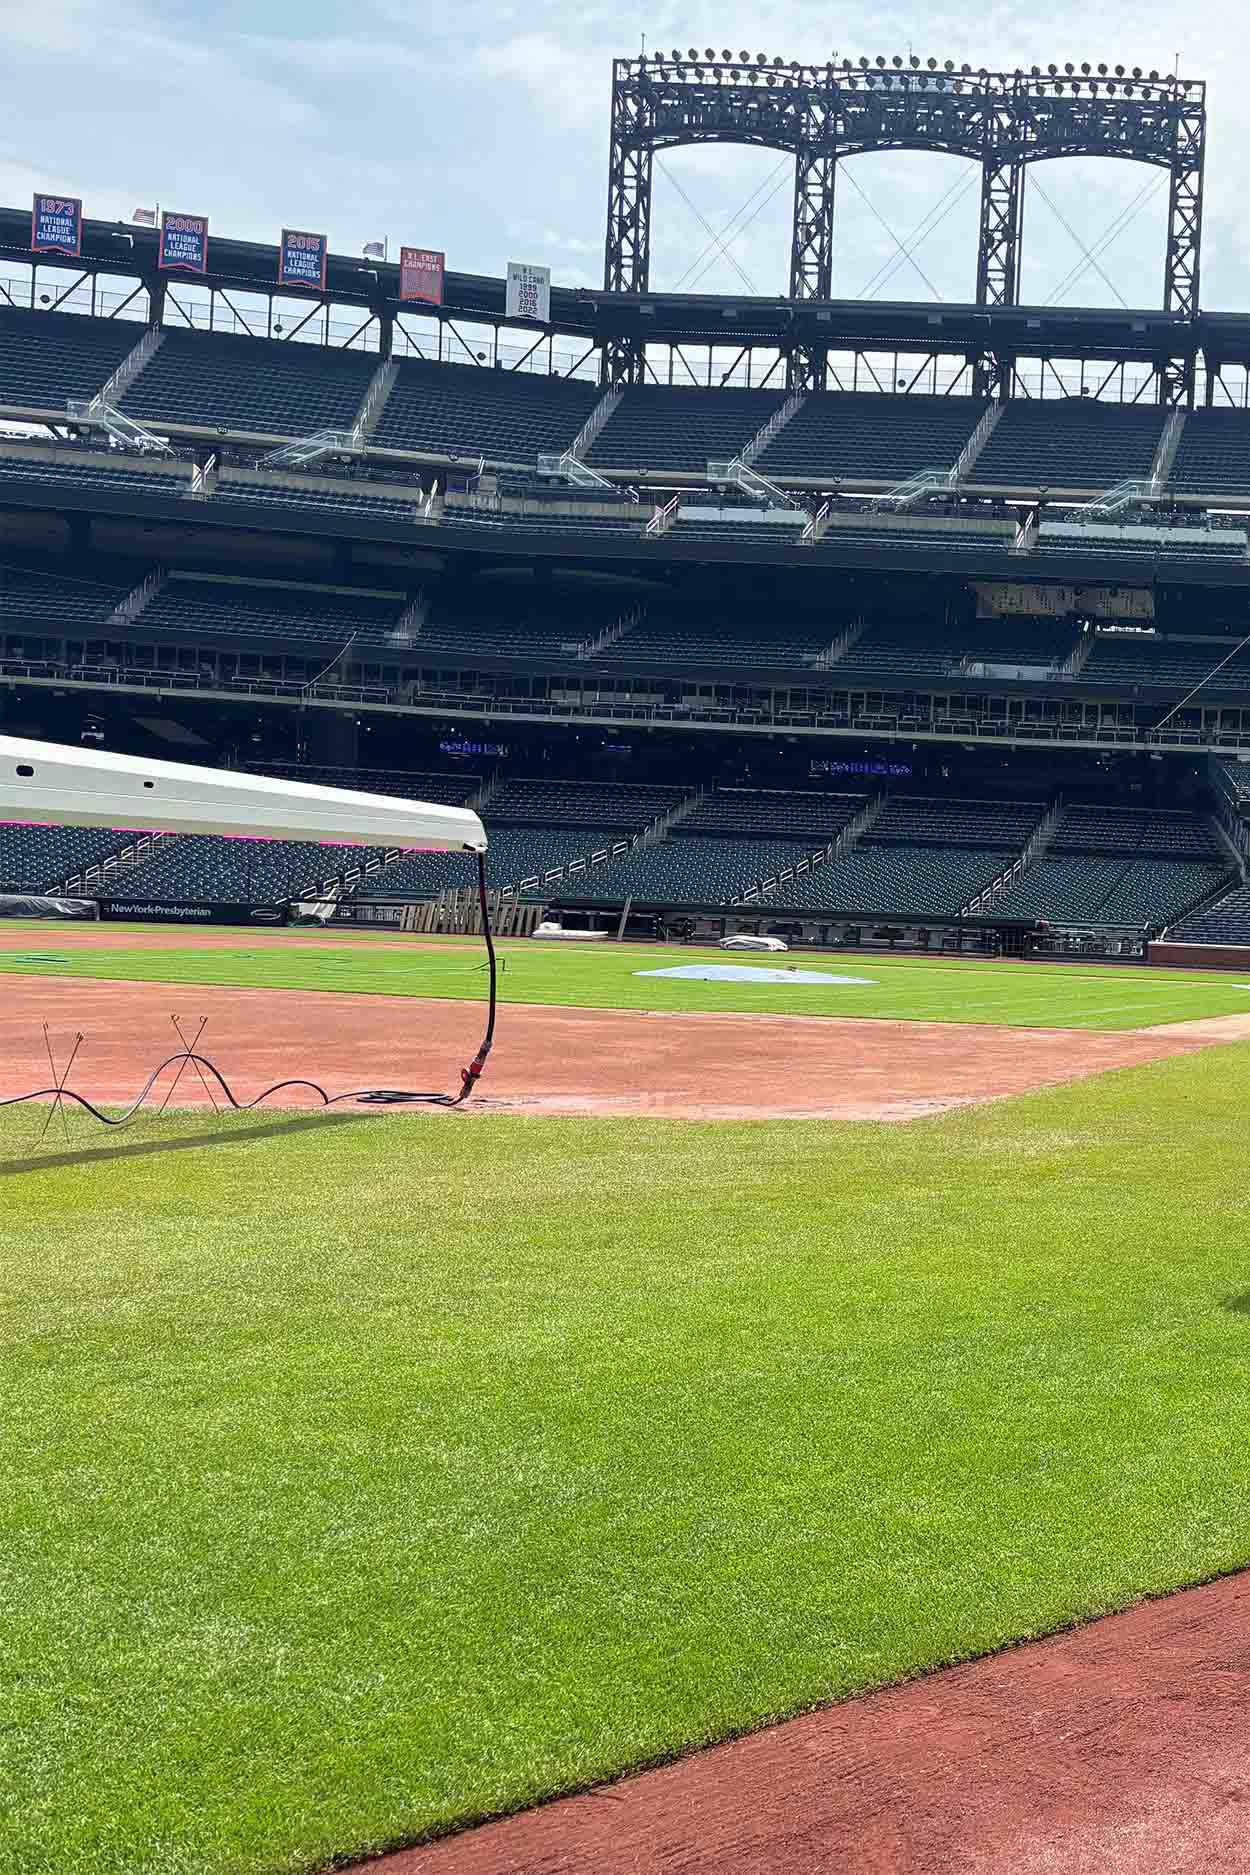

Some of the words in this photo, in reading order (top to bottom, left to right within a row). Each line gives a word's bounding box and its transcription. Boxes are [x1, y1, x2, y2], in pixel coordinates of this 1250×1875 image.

[41, 199, 74, 216] 1973
[40, 215, 74, 227] NATIONAL
[166, 216, 203, 234] 2000
[43, 224, 71, 235] LEAGUE
[36, 231, 76, 244] CHAMPIONS
[168, 232, 200, 245] NATIONAL
[287, 234, 320, 251] 2015
[170, 241, 197, 252] LEAGUE
[164, 248, 202, 261] CHAMPIONS
[288, 250, 319, 262] NATIONAL
[290, 259, 316, 269] LEAGUE
[404, 259, 441, 272] CHAMPIONS
[284, 265, 320, 278] CHAMPIONS
[519, 290, 538, 299] 2000
